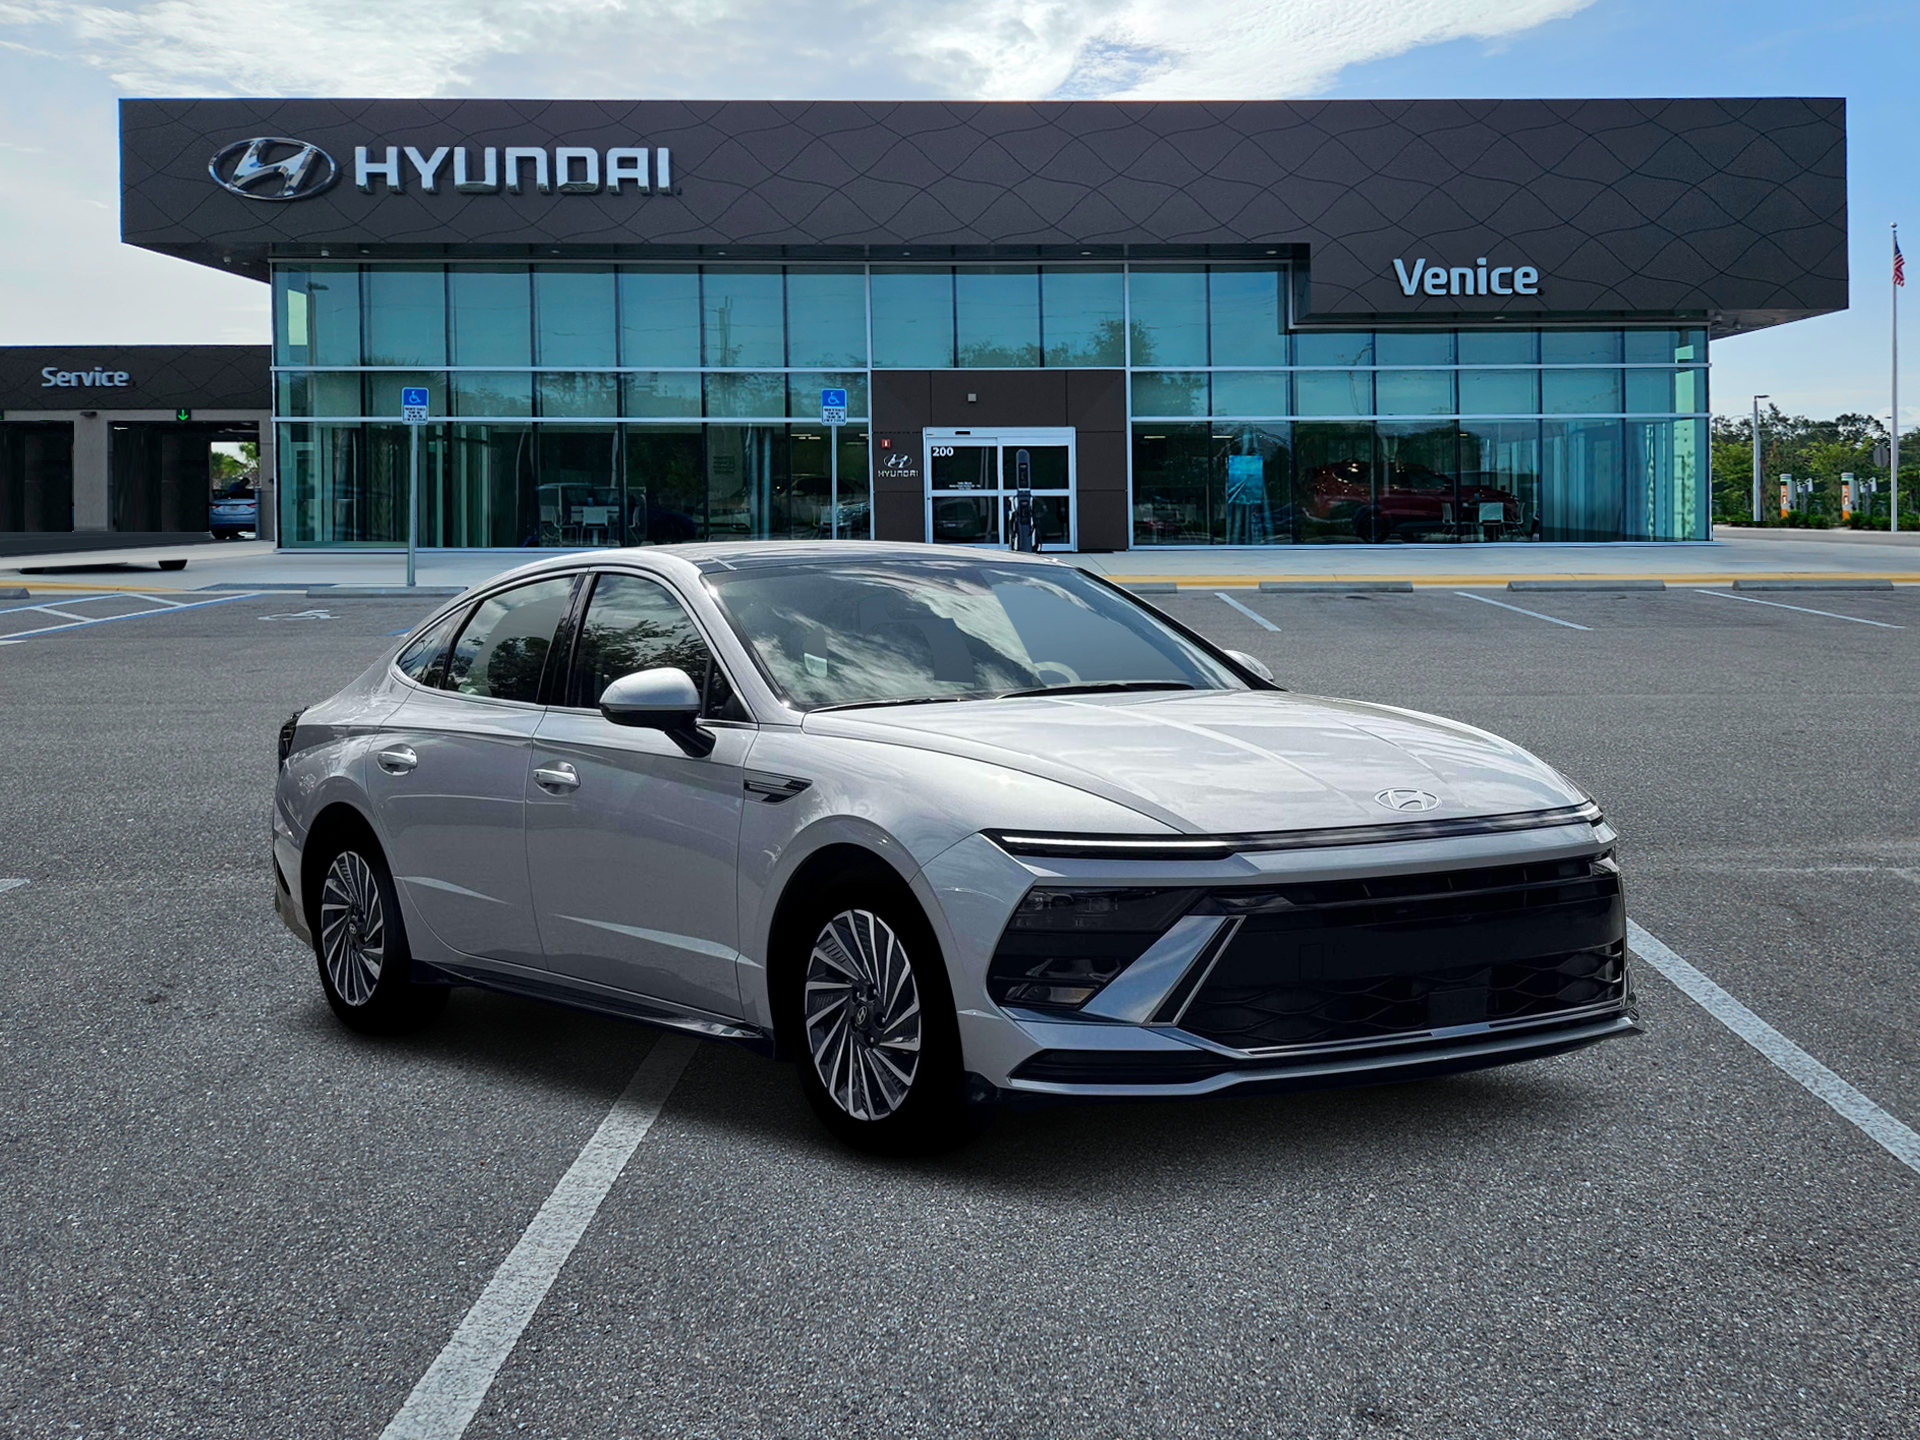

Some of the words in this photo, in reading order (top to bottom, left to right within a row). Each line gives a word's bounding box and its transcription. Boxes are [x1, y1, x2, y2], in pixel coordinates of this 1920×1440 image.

[354, 145, 673, 195] HYUNDAI
[1393, 257, 1539, 296] Venice
[41, 366, 130, 387] Service
[932, 446, 954, 457] 200
[877, 469, 919, 478] HYUNDAI
